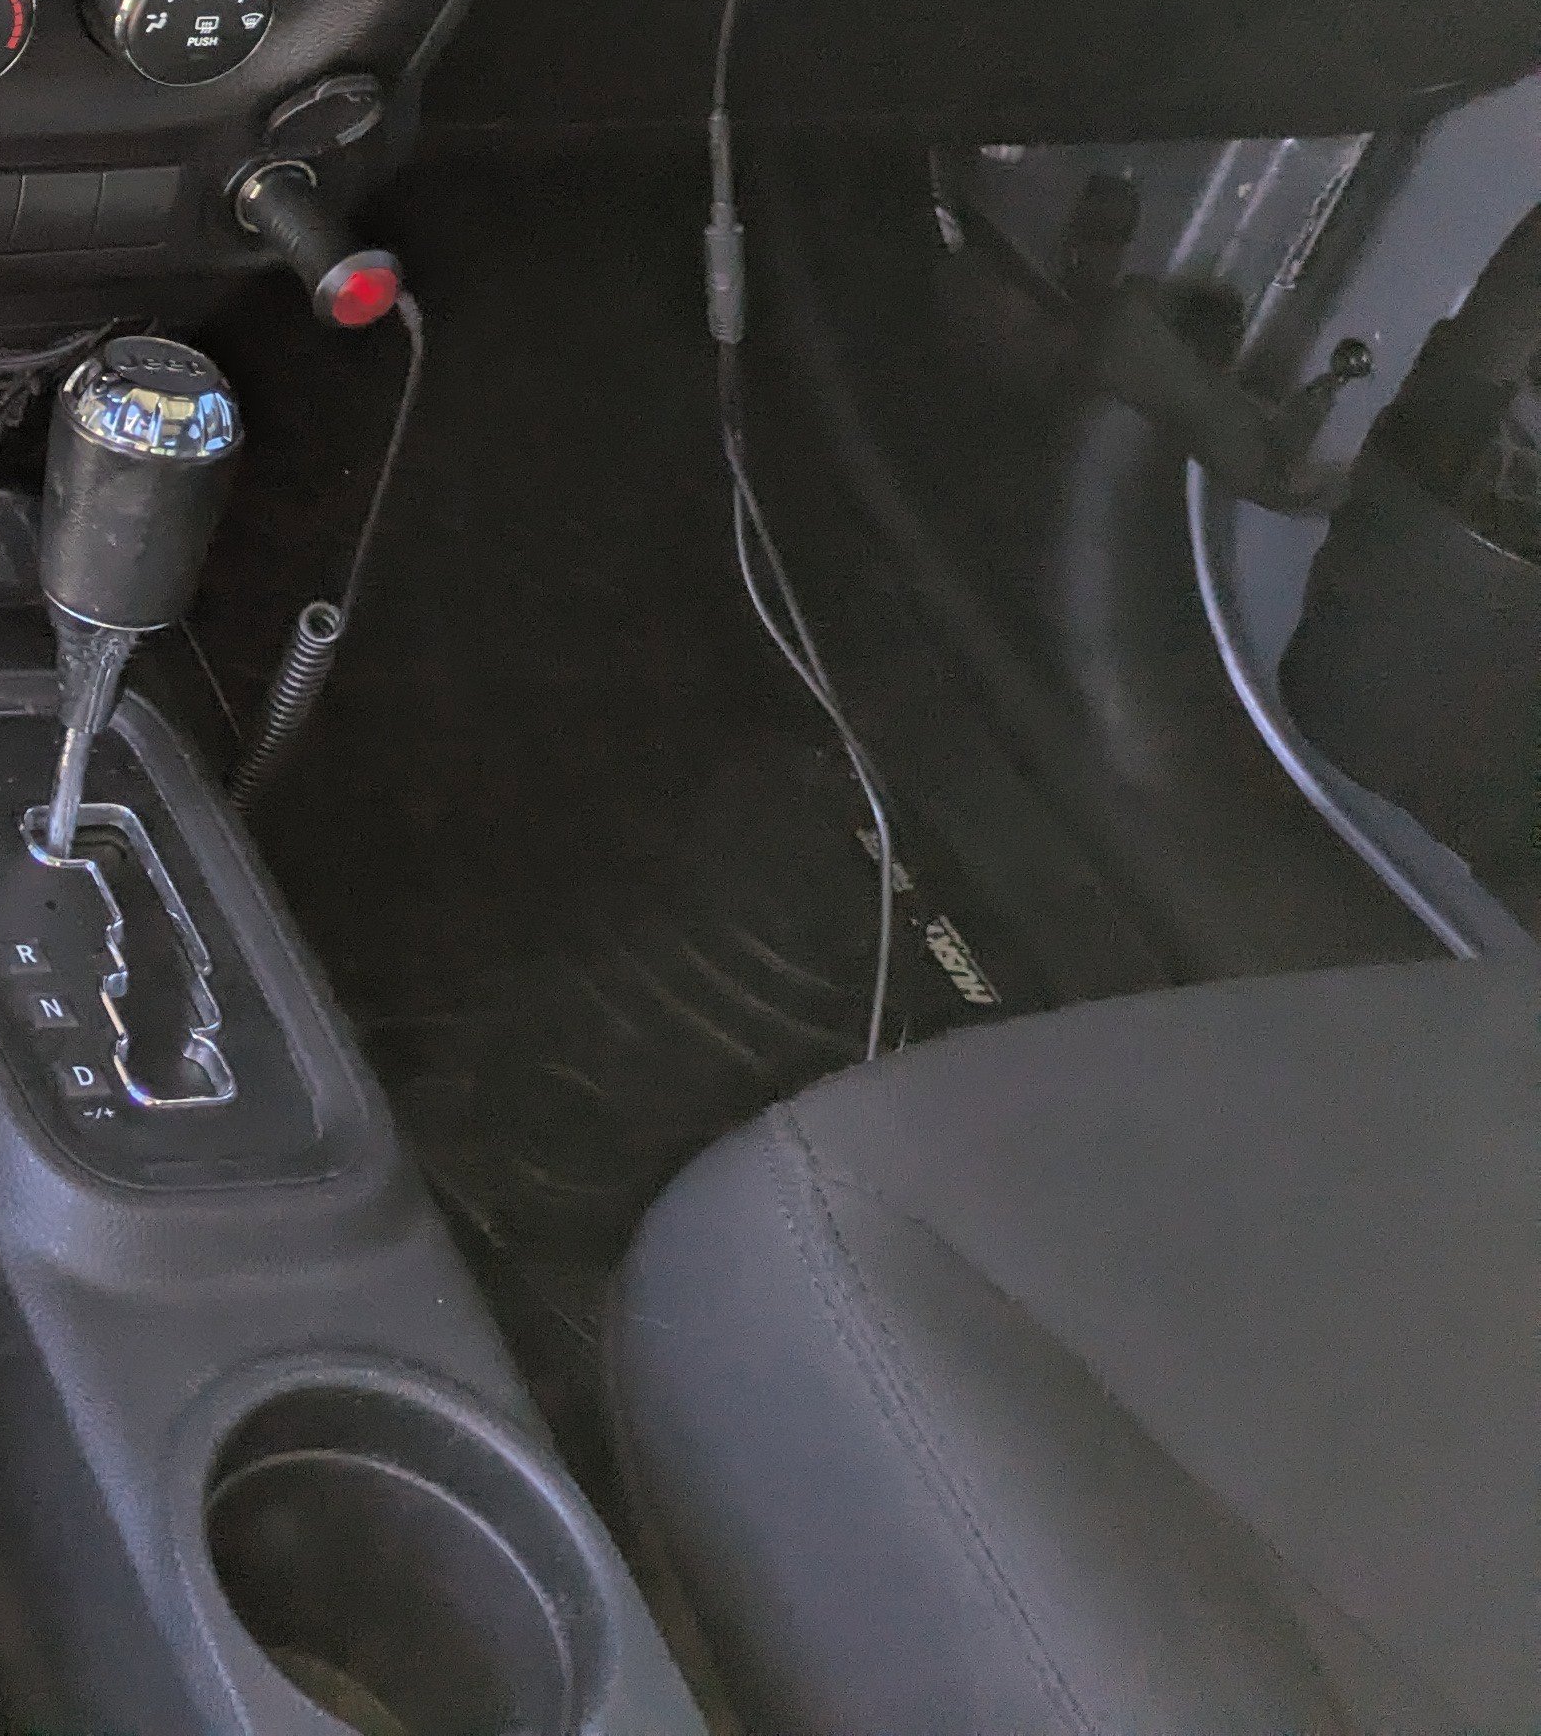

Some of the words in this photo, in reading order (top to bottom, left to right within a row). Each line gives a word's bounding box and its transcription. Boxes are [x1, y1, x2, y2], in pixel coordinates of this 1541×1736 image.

[187, 36, 218, 48] PUSH
[16, 944, 38, 964] R
[39, 999, 63, 1018] N
[71, 1066, 94, 1087] D
